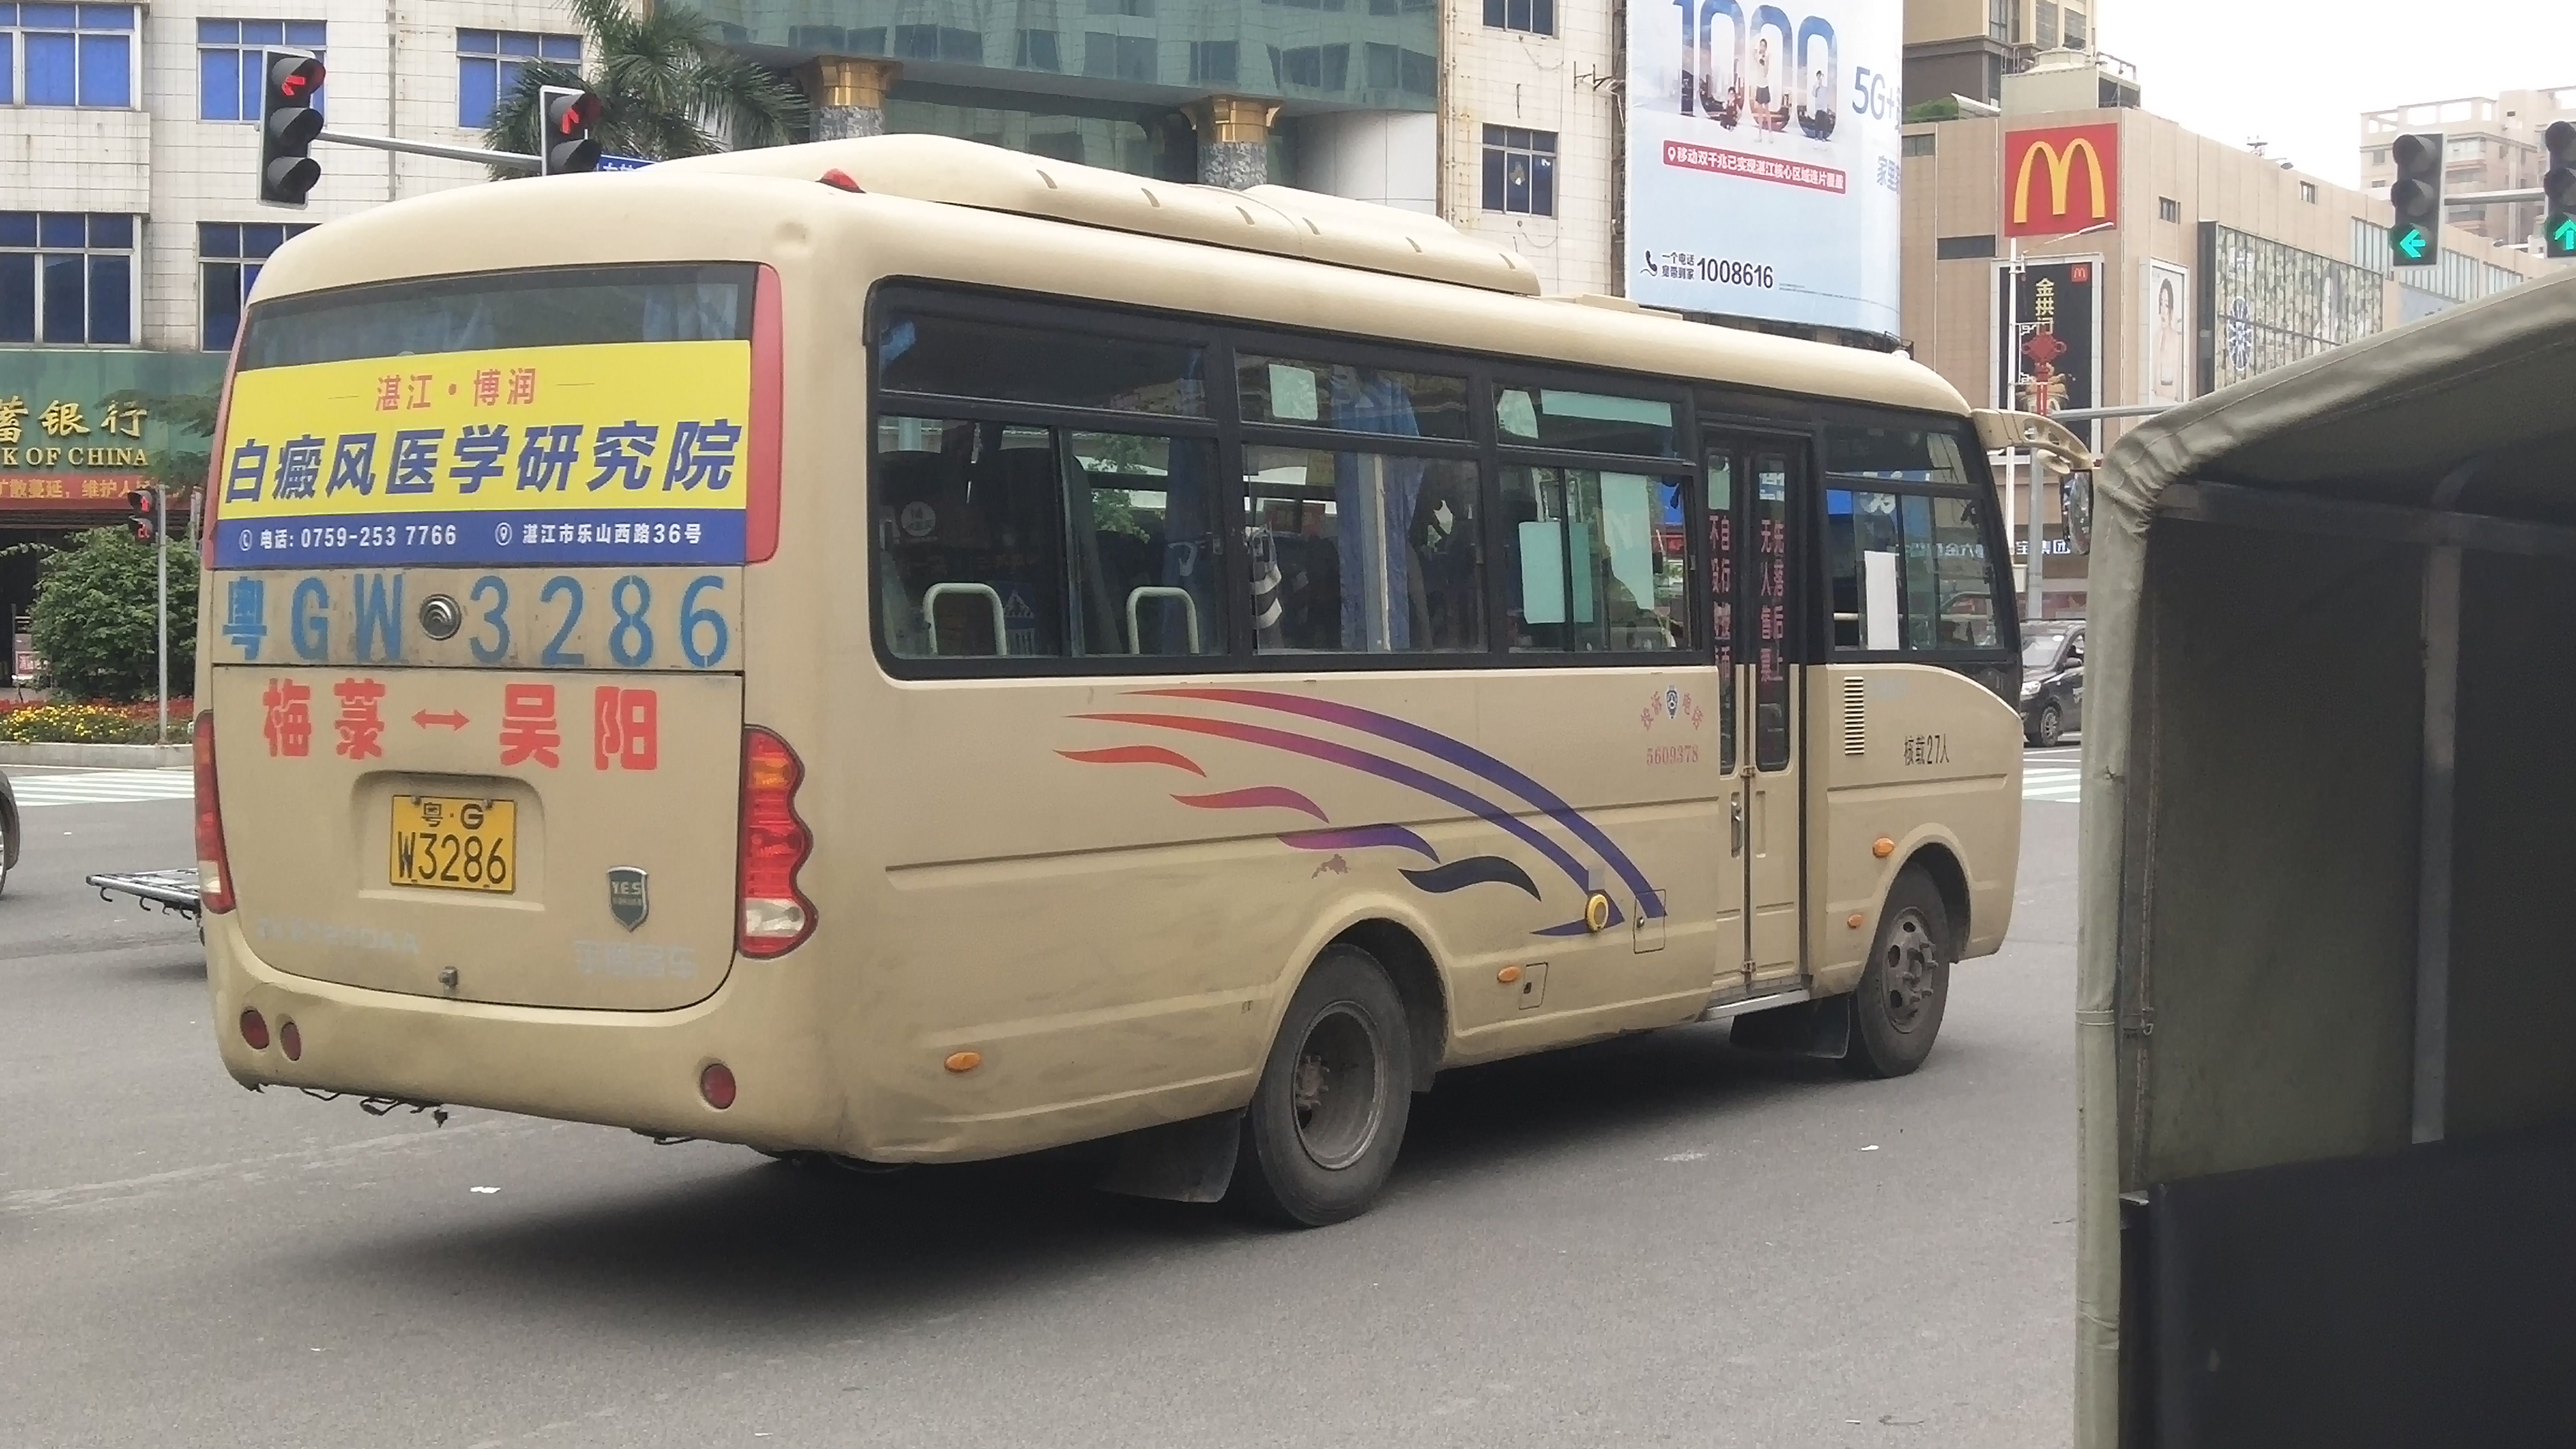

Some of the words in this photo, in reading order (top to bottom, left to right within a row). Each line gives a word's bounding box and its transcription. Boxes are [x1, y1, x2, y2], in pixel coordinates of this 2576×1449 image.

[1662, 252, 1694, 266] 一个电话
[1697, 257, 1773, 289] 1008616
[26, 447, 61, 465] OF
[68, 447, 148, 466] CHINA
[225, 417, 742, 505] 白癜风医学研究院
[300, 525, 397, 548] 0759-253
[405, 524, 457, 546] 7766
[523, 523, 702, 544] 湛江市乐山西路36号
[468, 574, 730, 670] 3286
[1646, 744, 1699, 766] 5609378
[1904, 733, 1949, 766] 核载27人
[397, 830, 507, 885] W3286
[611, 880, 642, 895] YES
